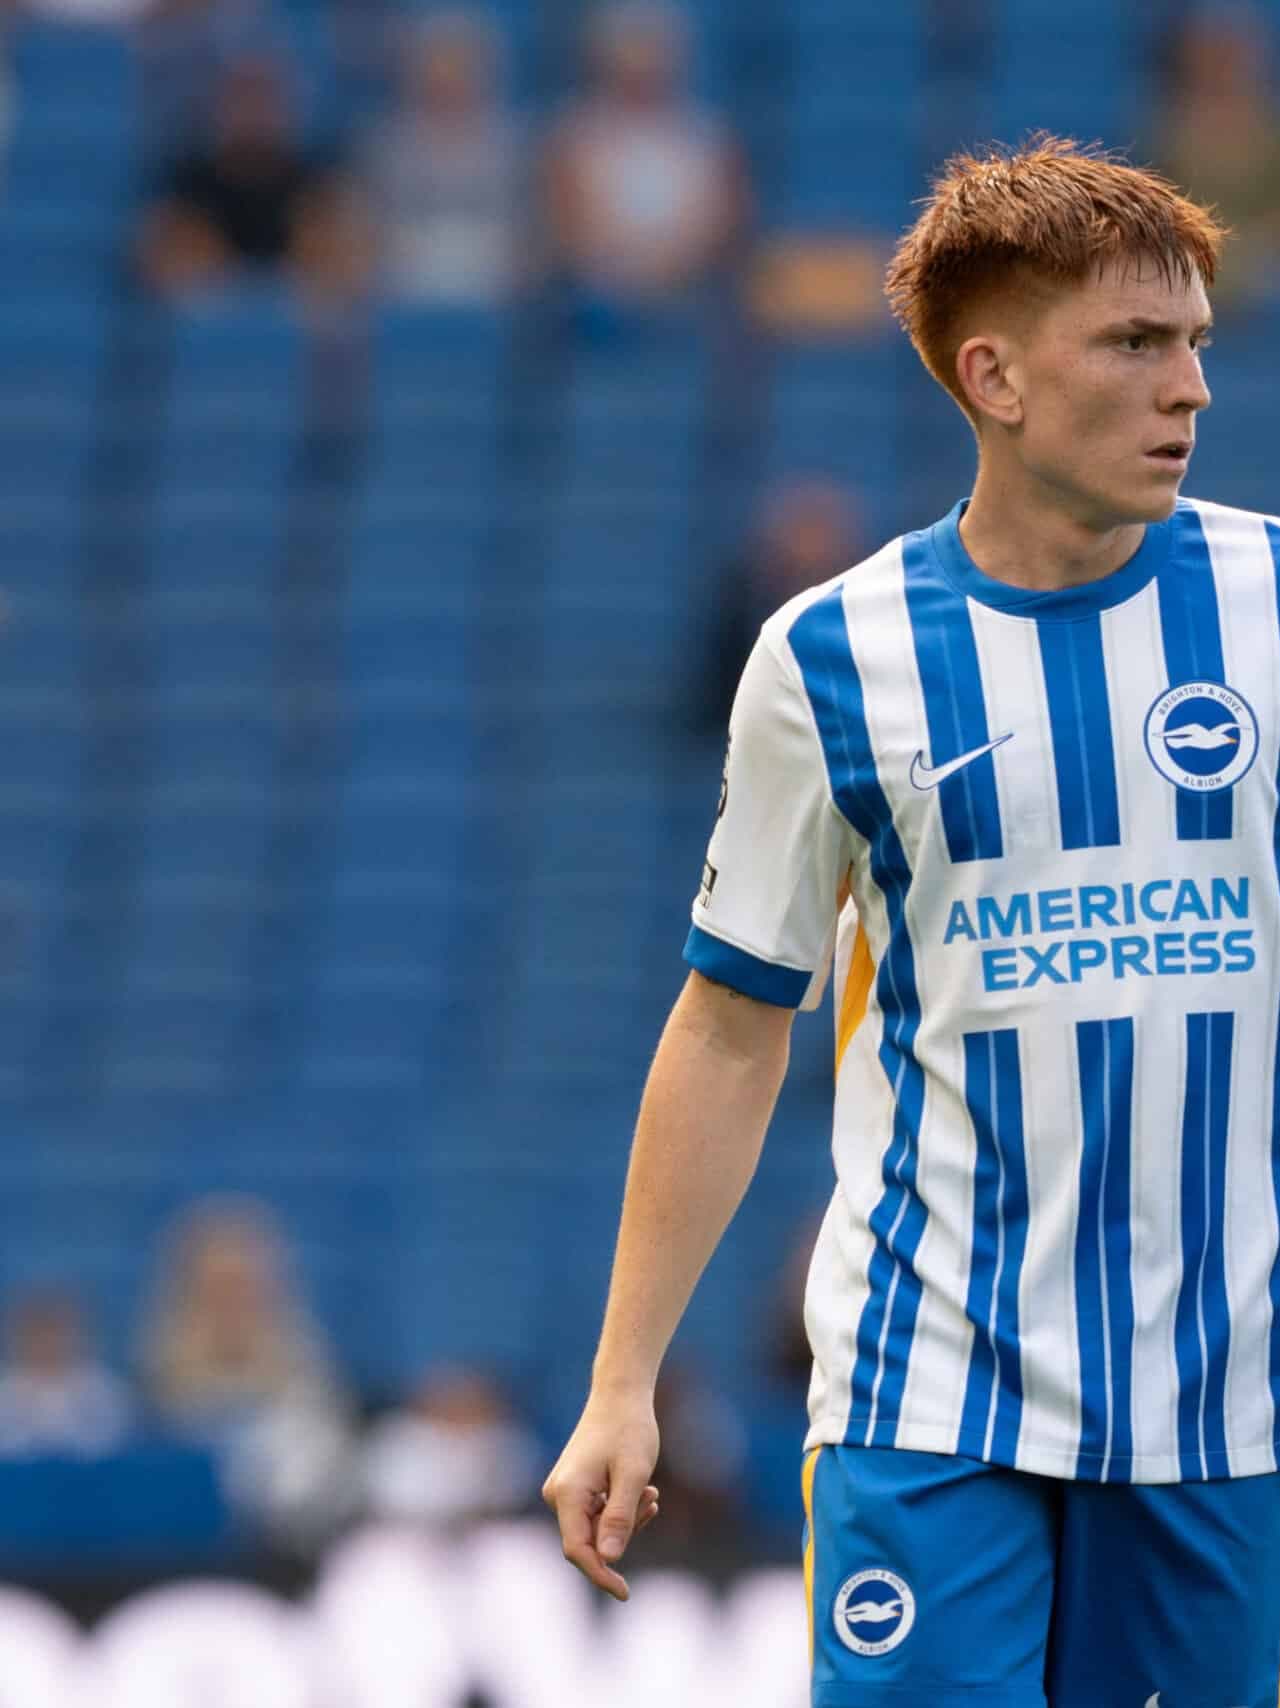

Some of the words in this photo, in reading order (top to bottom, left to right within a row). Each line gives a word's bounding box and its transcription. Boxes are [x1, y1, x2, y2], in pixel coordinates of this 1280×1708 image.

[1159, 686, 1203, 715] BRIGHTON
[1220, 693, 1243, 715] HOVE
[1184, 776, 1223, 788] ALBION
[943, 877, 1249, 945] AMERICAN
[981, 930, 1256, 992] EXPRESS
